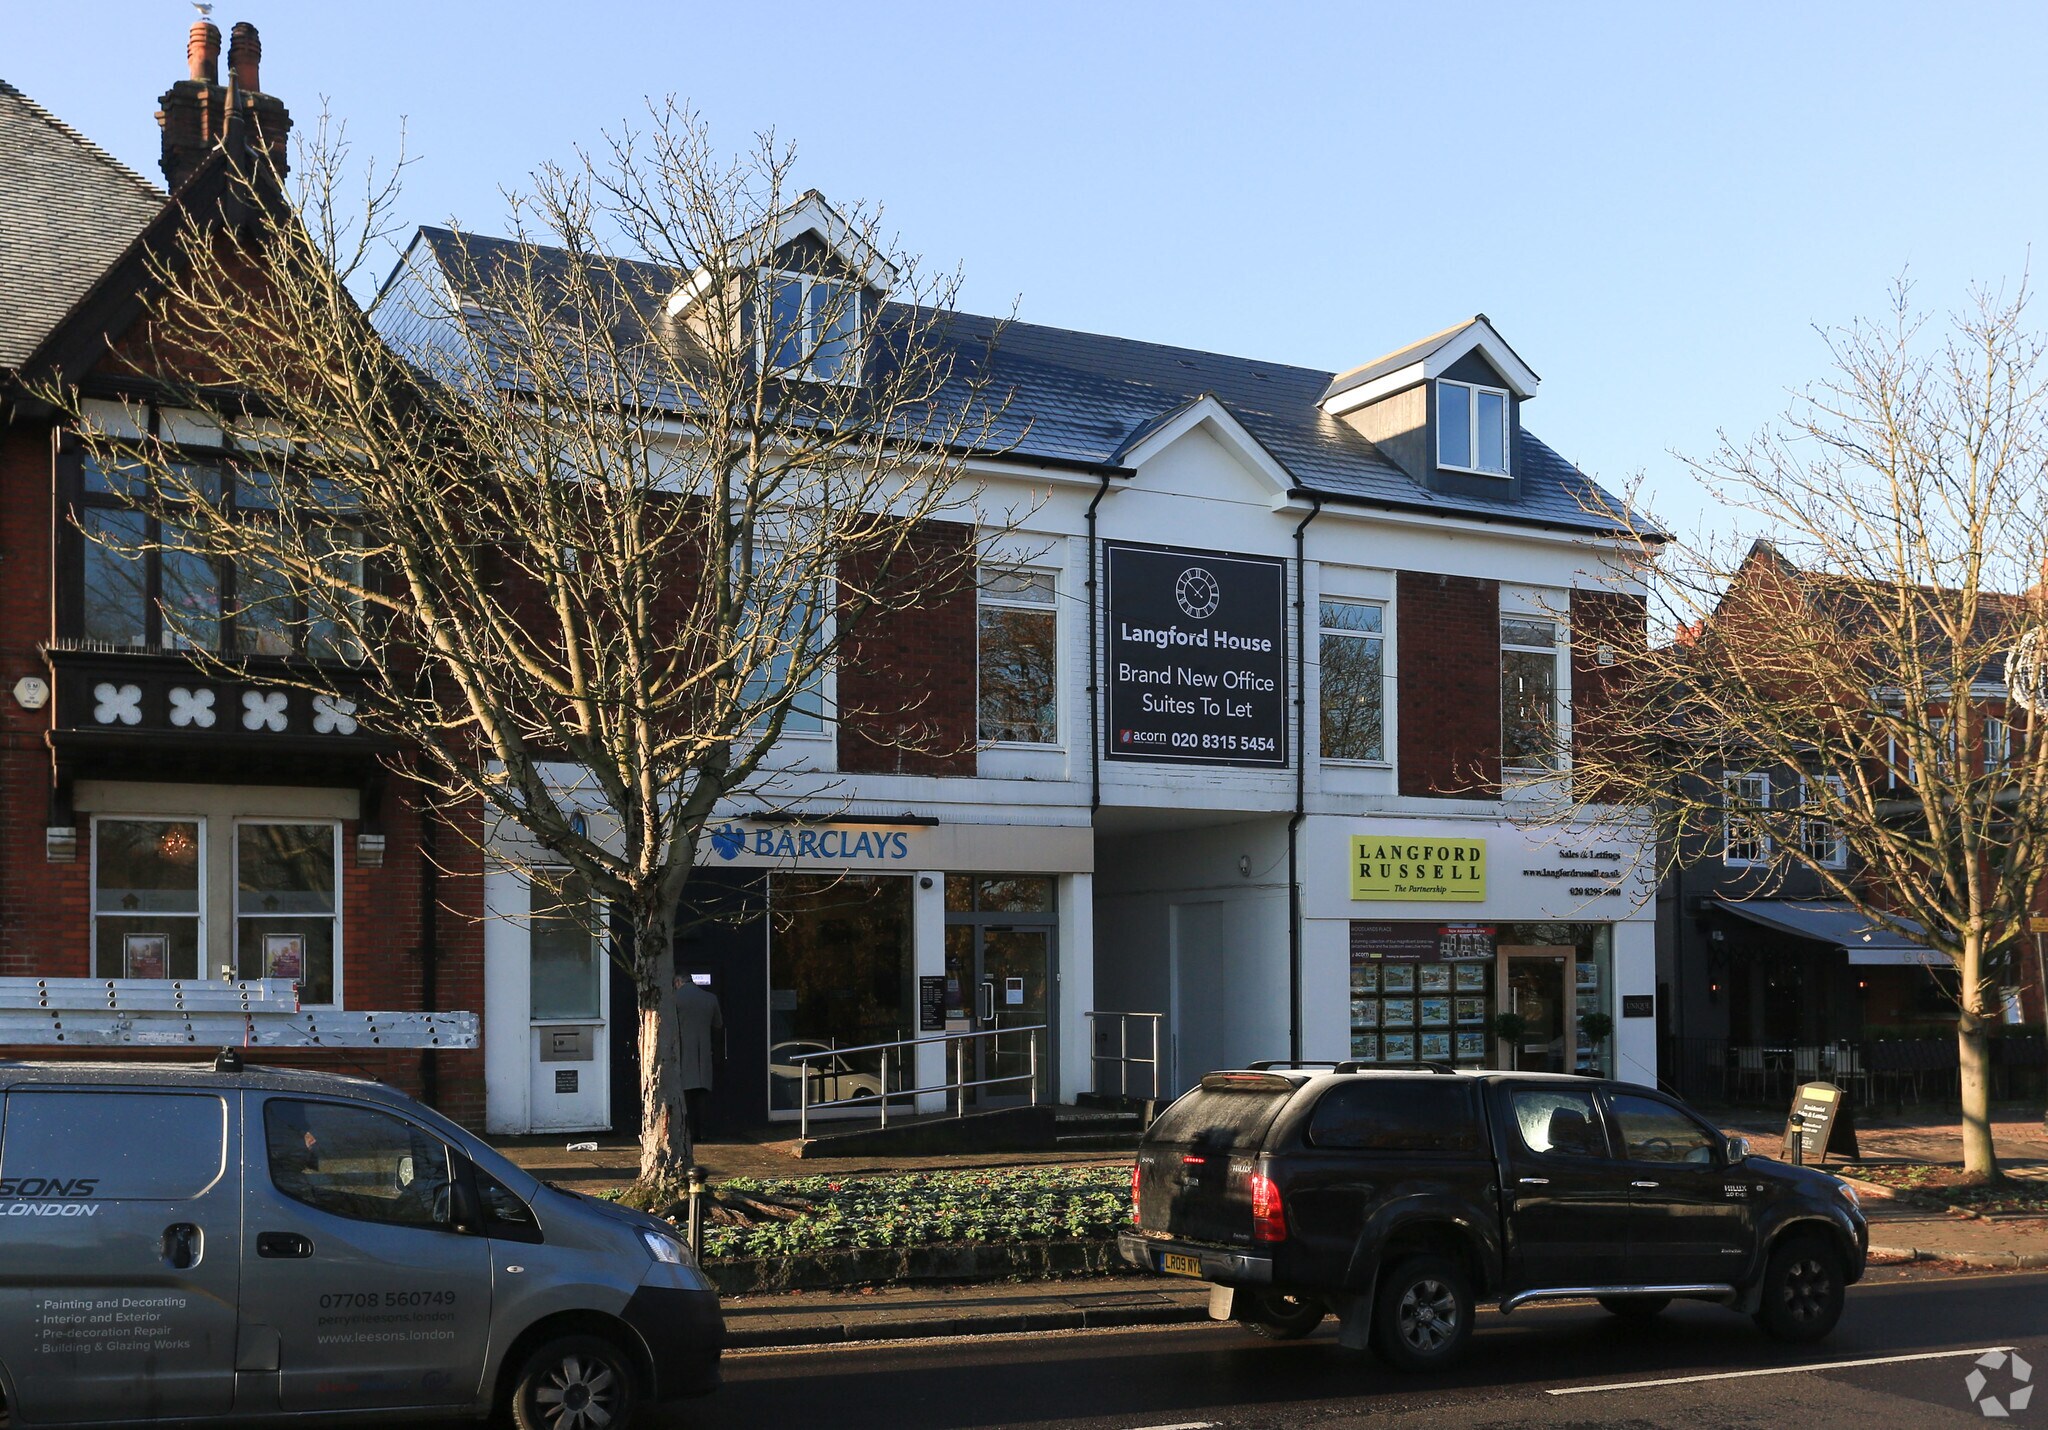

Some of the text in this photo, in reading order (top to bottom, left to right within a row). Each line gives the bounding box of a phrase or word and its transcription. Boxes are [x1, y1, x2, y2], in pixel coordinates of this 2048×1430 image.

[1121, 622, 1272, 652] Langford House
[1119, 662, 1275, 692] Brand New Office
[1142, 693, 1252, 718] Suites To Let
[1133, 731, 1275, 752] acorn 020 8315 5454
[755, 828, 908, 860] BARCLAYS
[1359, 844, 1480, 862] LANGFORD
[1559, 849, 1621, 861] Sales & Lettings
[1359, 863, 1481, 880] RUSSELL
[1394, 884, 1447, 895] The Partnership
[1569, 887, 1584, 896] 020
[1165, 1254, 1186, 1271] LR09
[44, 1297, 187, 1311] Painting and Decorating
[319, 1290, 456, 1309] 07708 560749
[43, 1312, 161, 1324] Interior and Exterior
[43, 1325, 172, 1339] Pre-decoration Repair
[317, 1329, 455, 1344] www.leesons.london
[42, 1339, 191, 1354] Building & Glazing Works
